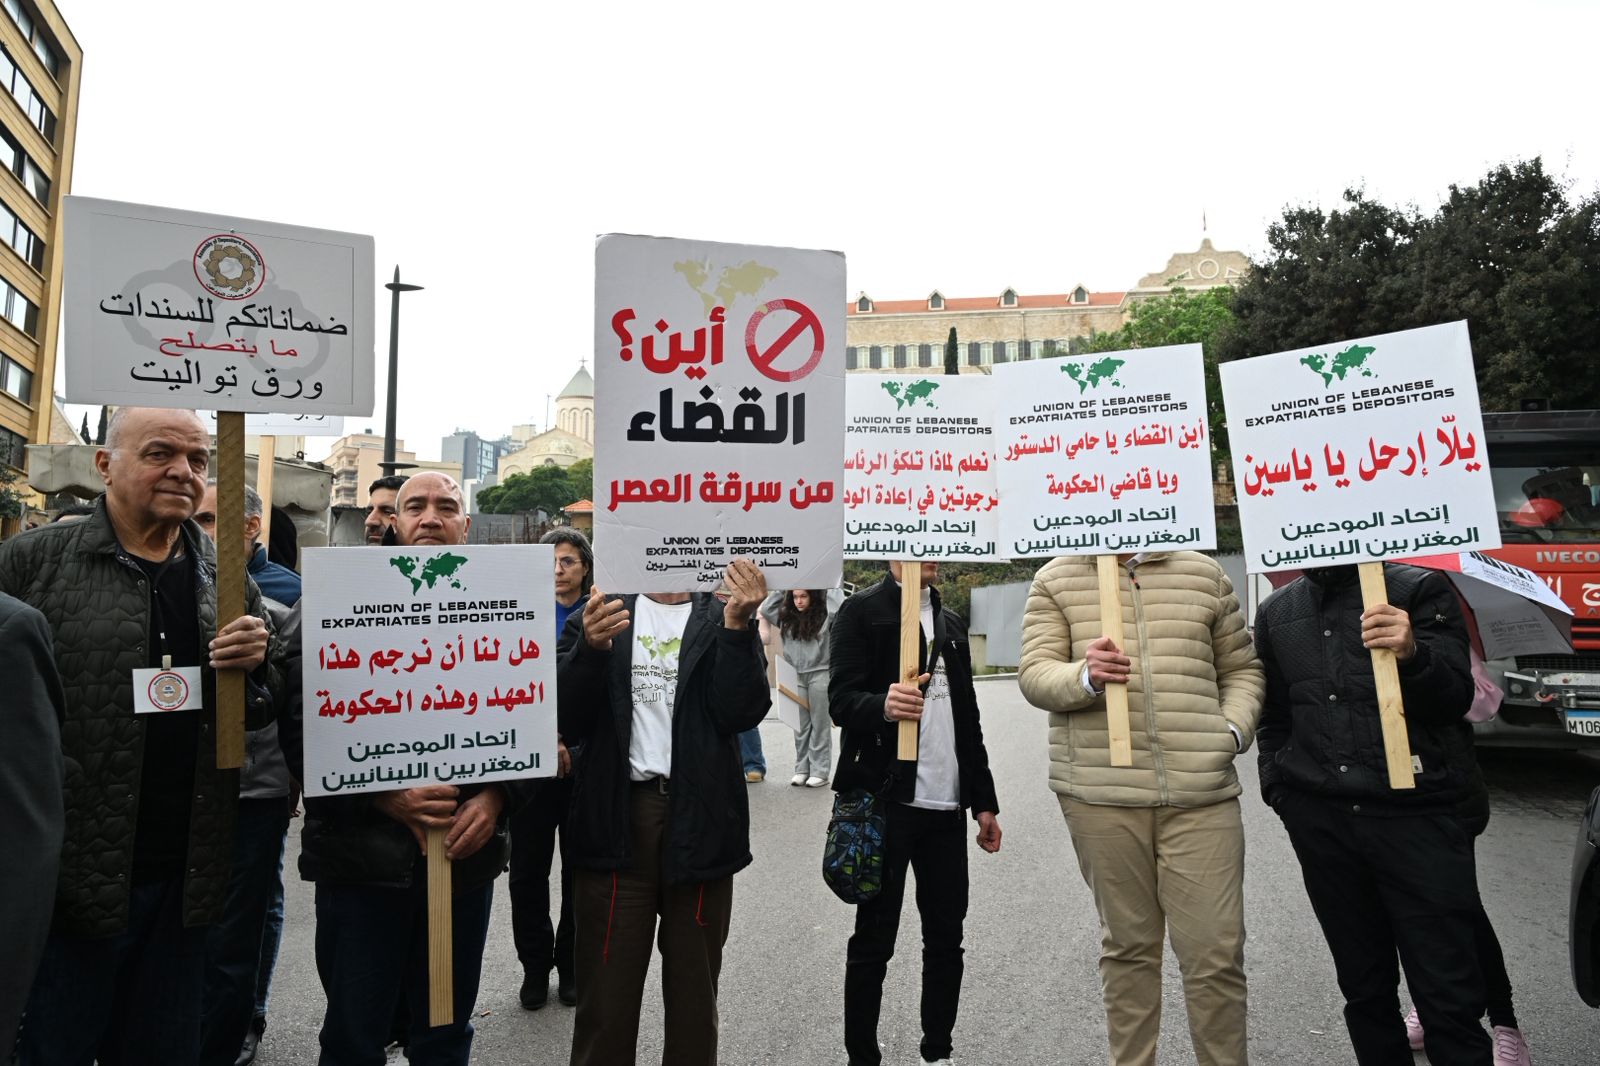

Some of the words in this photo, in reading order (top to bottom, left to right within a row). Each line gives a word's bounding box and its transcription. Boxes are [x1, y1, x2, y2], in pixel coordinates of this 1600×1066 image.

[99, 292, 214, 324] للسندات
[225, 303, 348, 337] ضماناتكم
[270, 339, 298, 358] ما
[610, 306, 726, 381] أين؟
[251, 367, 323, 400] ورق
[1271, 397, 1319, 412] UNION
[1325, 393, 1346, 404] OF
[1352, 379, 1435, 400] LEBANESE
[626, 384, 806, 446] القضاء
[1009, 411, 1097, 425] EXPATRIATES
[1102, 402, 1188, 417] DEPOSITORS
[1033, 402, 1075, 413] UNION
[1079, 399, 1097, 408] OF
[1102, 393, 1172, 407] LEBANESE
[1245, 404, 1347, 428] EXPATRIATES
[1352, 387, 1455, 412] DEPOSITORS
[846, 426, 911, 434] PATRIATES
[915, 426, 993, 435] DEPOSITORS
[853, 416, 891, 424] UNION
[916, 417, 979, 425] LEBANESE
[1178, 417, 1205, 449] أين
[1003, 434, 1061, 461] الدستور
[1065, 431, 1100, 460] حامي
[1105, 429, 1119, 455] يا
[1123, 423, 1173, 448] القضاء
[844, 449, 888, 475] الرئاس
[890, 449, 924, 476] تلكؤ
[929, 449, 953, 473] لماذا
[957, 450, 989, 478] نعلم
[1323, 442, 1351, 489] يا
[1358, 431, 1428, 482] إرحل
[1045, 472, 1105, 500] الحكومة
[1109, 466, 1152, 500] قاضي
[1157, 467, 1179, 495] ويا
[1243, 447, 1318, 497] ياسين
[606, 472, 692, 513] العصر
[699, 471, 782, 513] سرقة
[789, 477, 834, 510] من
[874, 484, 912, 511] إعادة
[917, 484, 935, 515] في
[845, 519, 928, 536] المودعين
[931, 519, 976, 537] إتحاد
[1033, 508, 1122, 532] المودعين
[1127, 505, 1177, 524] إتحاد
[1280, 511, 1385, 542] المودعين
[1390, 504, 1450, 526] إتحاد
[645, 547, 725, 556] EXPATRIATES
[730, 546, 800, 555] DEPOSITORS
[663, 537, 700, 545] UNION
[705, 537, 721, 545] OF
[726, 536, 784, 545] LEBANESE
[843, 539, 906, 556] اللبنانيي
[910, 541, 996, 557] المغتربين
[1014, 532, 1100, 555] اللبنانيين
[1104, 527, 1201, 551] المغتربين
[1365, 526, 1480, 558] المغتربين
[1260, 539, 1360, 568] اللبنانيين
[1536, 551, 1600, 564] IVECO
[321, 615, 432, 629] EXPATRIATES
[437, 611, 536, 625] DEPOSITORS
[352, 603, 405, 614] UNION
[410, 602, 433, 613] OF
[438, 600, 518, 612] LEBANESE
[318, 642, 361, 671] هذا
[369, 638, 433, 677] نرجم
[439, 633, 464, 671] أن
[473, 635, 501, 662] لنا
[508, 636, 541, 667] هل
[315, 688, 413, 724] الحكومة
[420, 683, 478, 715] وهذه
[486, 680, 544, 713] العهد
[347, 733, 455, 763] المودعين
[460, 728, 516, 749] إتحاد
[321, 761, 429, 792] اللبنانيين
[434, 752, 541, 782] المغتربين
